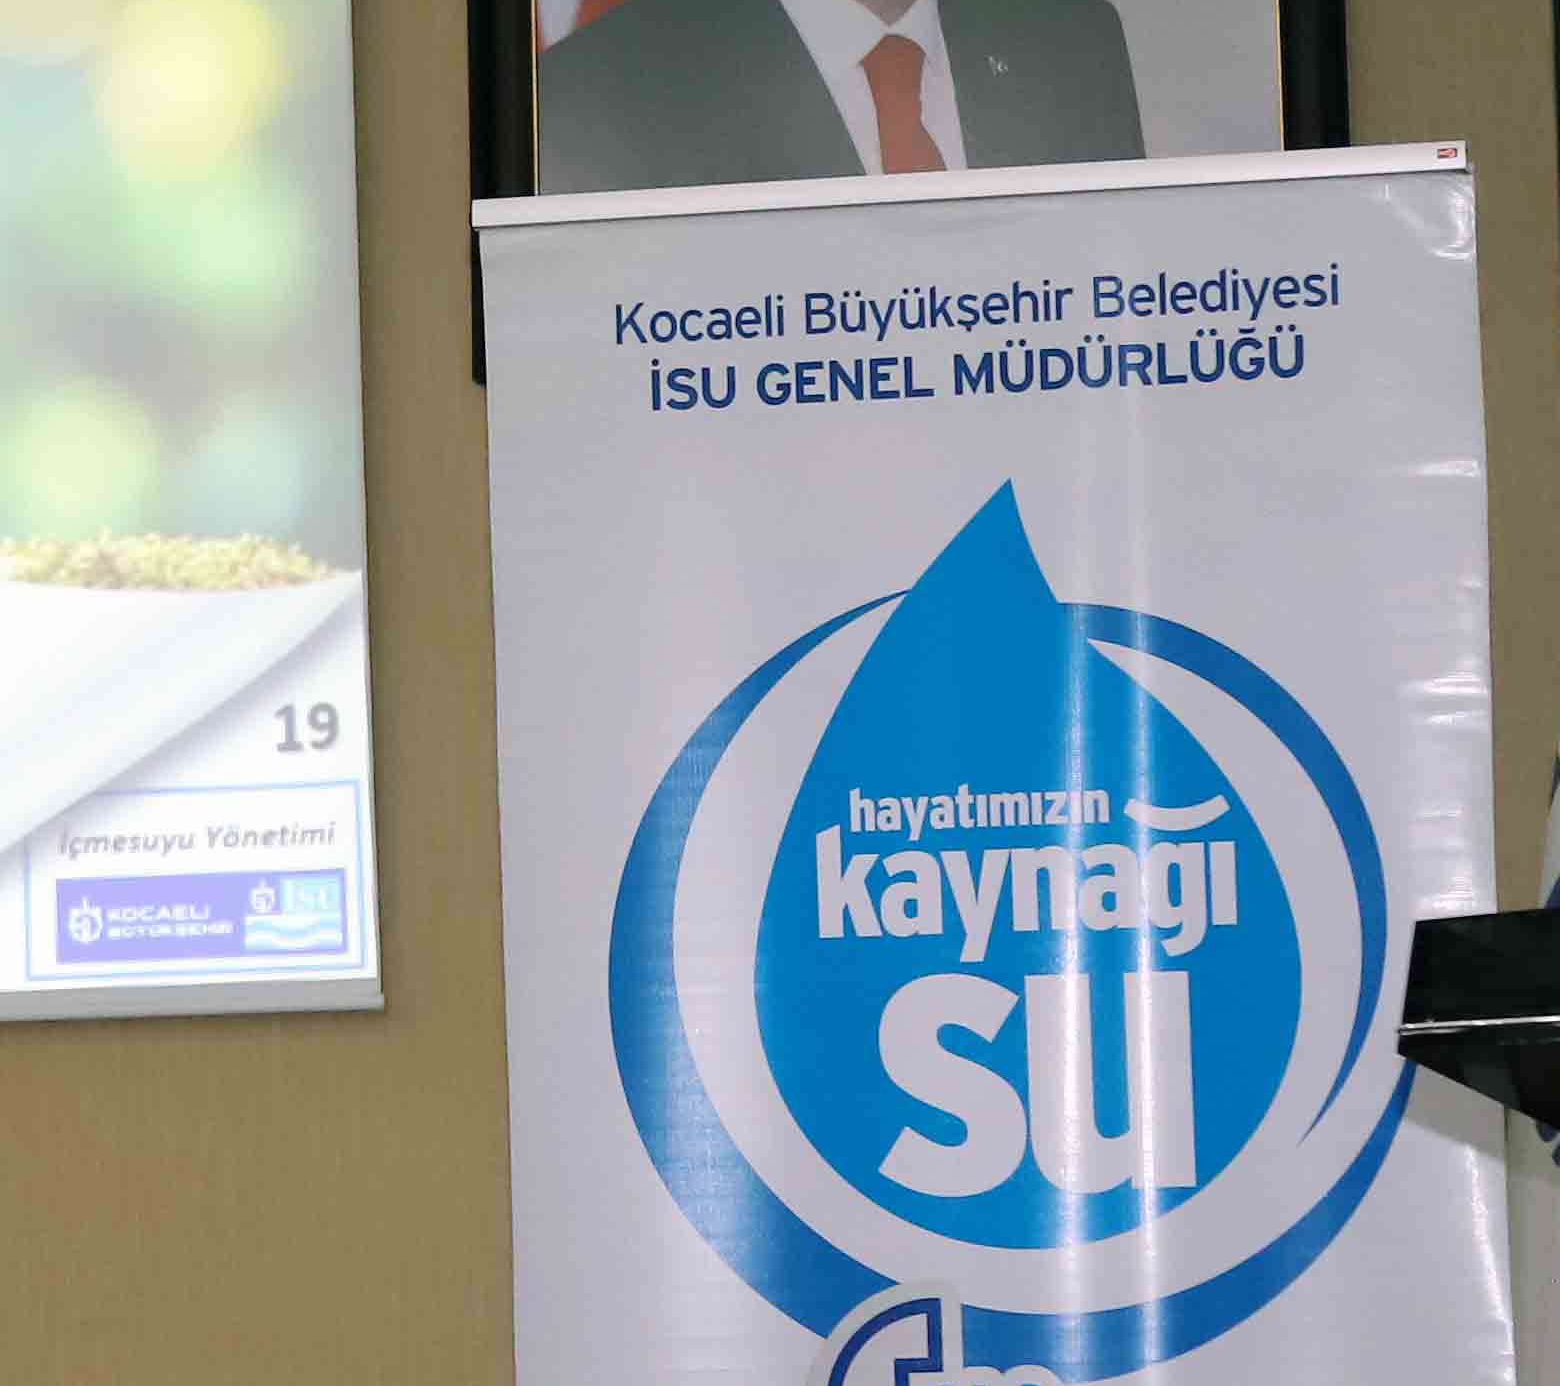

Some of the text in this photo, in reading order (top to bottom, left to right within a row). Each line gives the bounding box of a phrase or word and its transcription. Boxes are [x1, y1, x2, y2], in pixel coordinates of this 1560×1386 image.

[614, 262, 1340, 345] Kocaeli Büyükşehir Belediyesi
[650, 323, 1305, 410] İSU GENEL MÜDÜRLÜĞÜ
[273, 701, 340, 753] 19
[205, 820, 337, 851] Yönetimi
[849, 783, 1110, 841] hayatımızın
[815, 793, 1239, 962] kaynağı
